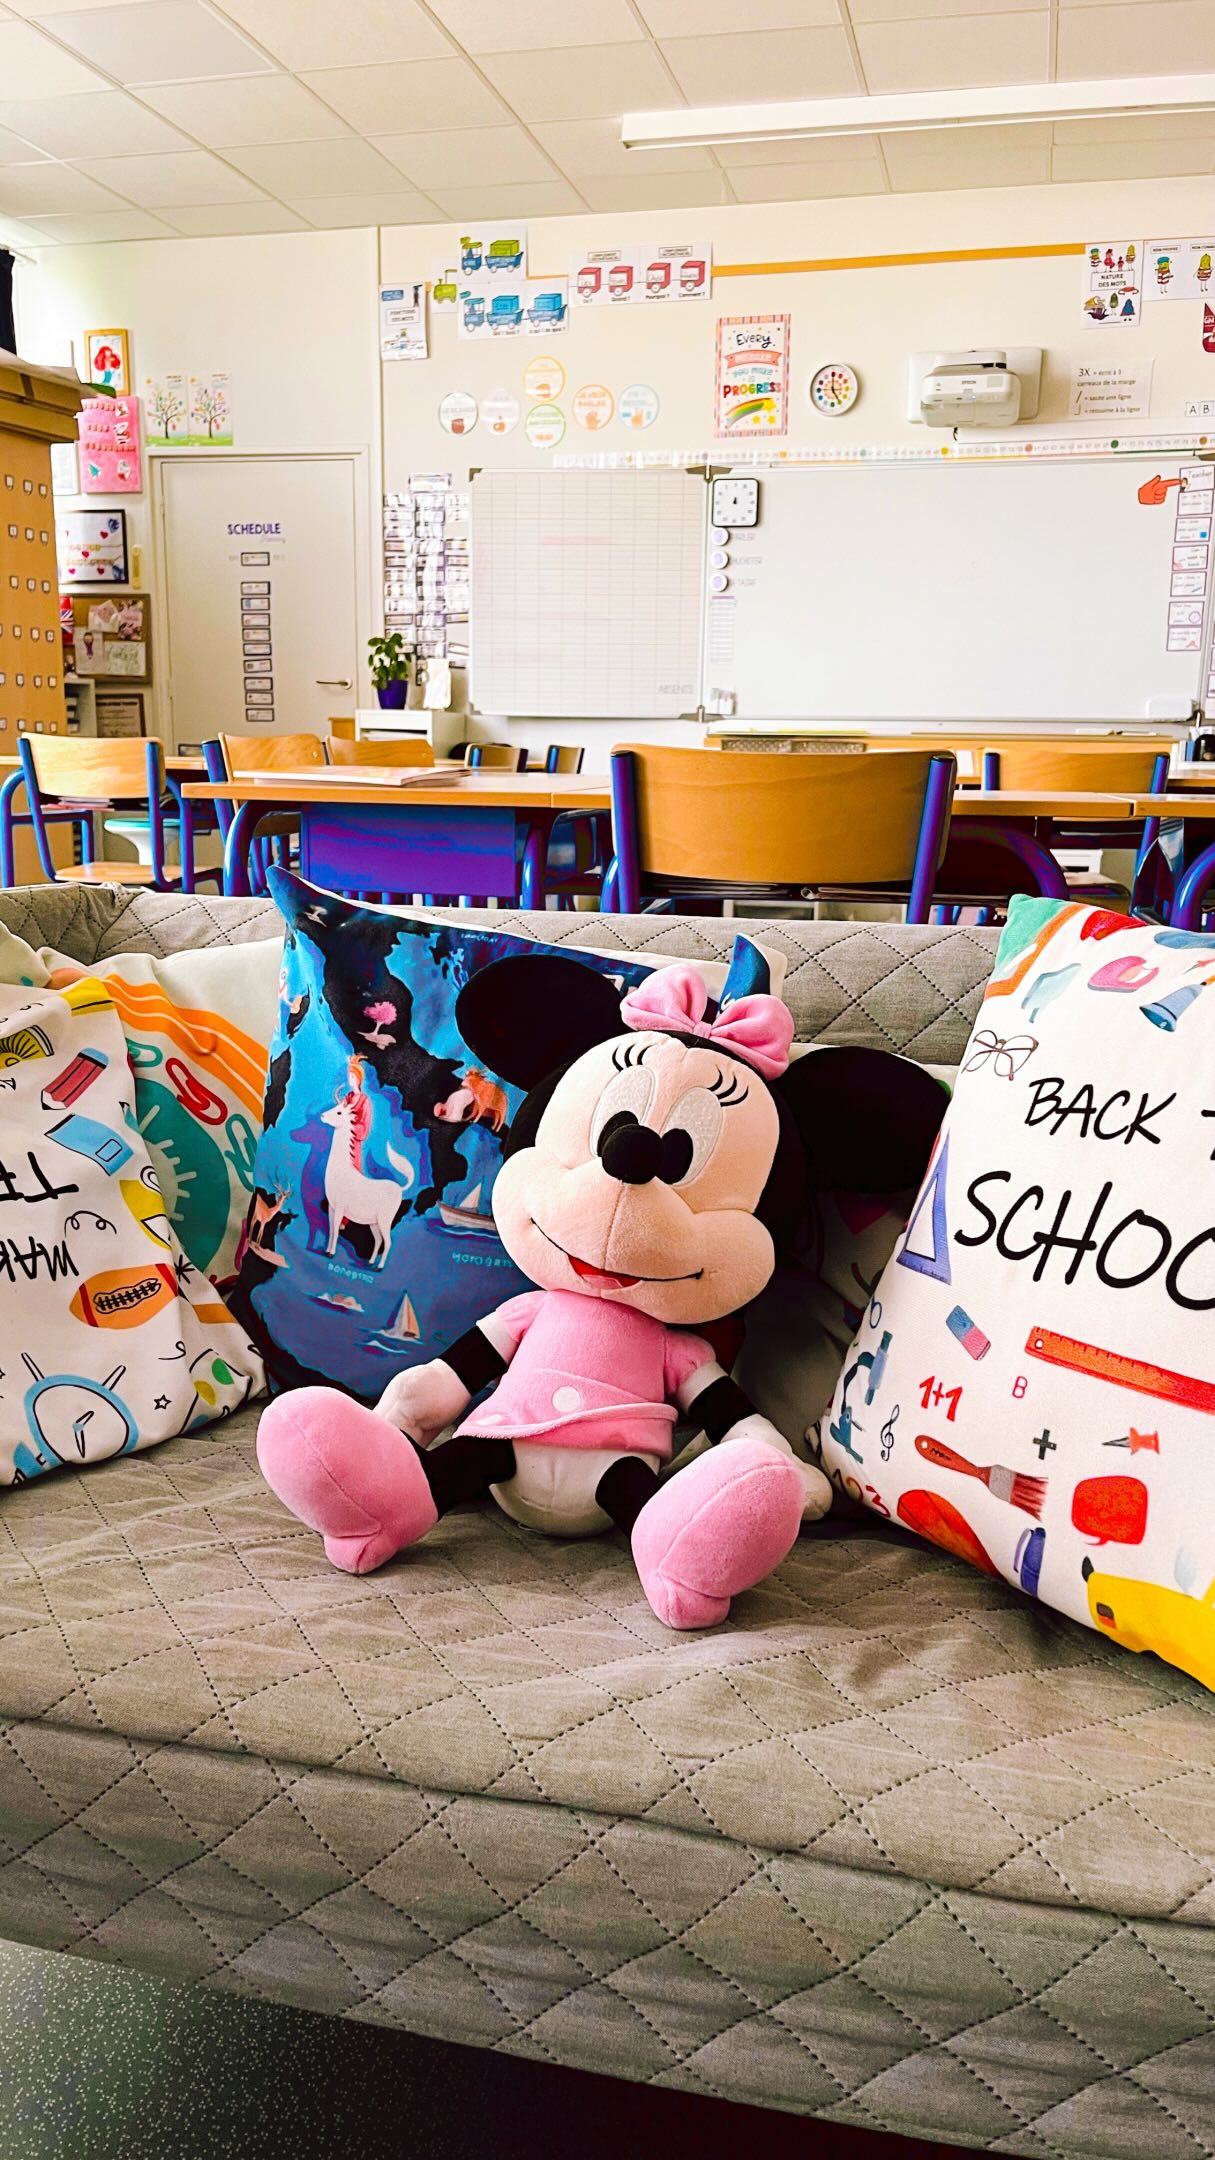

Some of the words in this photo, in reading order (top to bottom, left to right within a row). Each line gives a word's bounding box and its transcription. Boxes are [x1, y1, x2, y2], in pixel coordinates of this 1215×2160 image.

[1078, 368, 1091, 377] 3X
[723, 382, 782, 399] PROGRESS
[1189, 405, 1197, 414] A
[1203, 404, 1210, 414] B
[227, 523, 281, 535] SCHEDULE
[1024, 1077, 1177, 1145] BACK
[919, 1375, 963, 1422] 1+1
